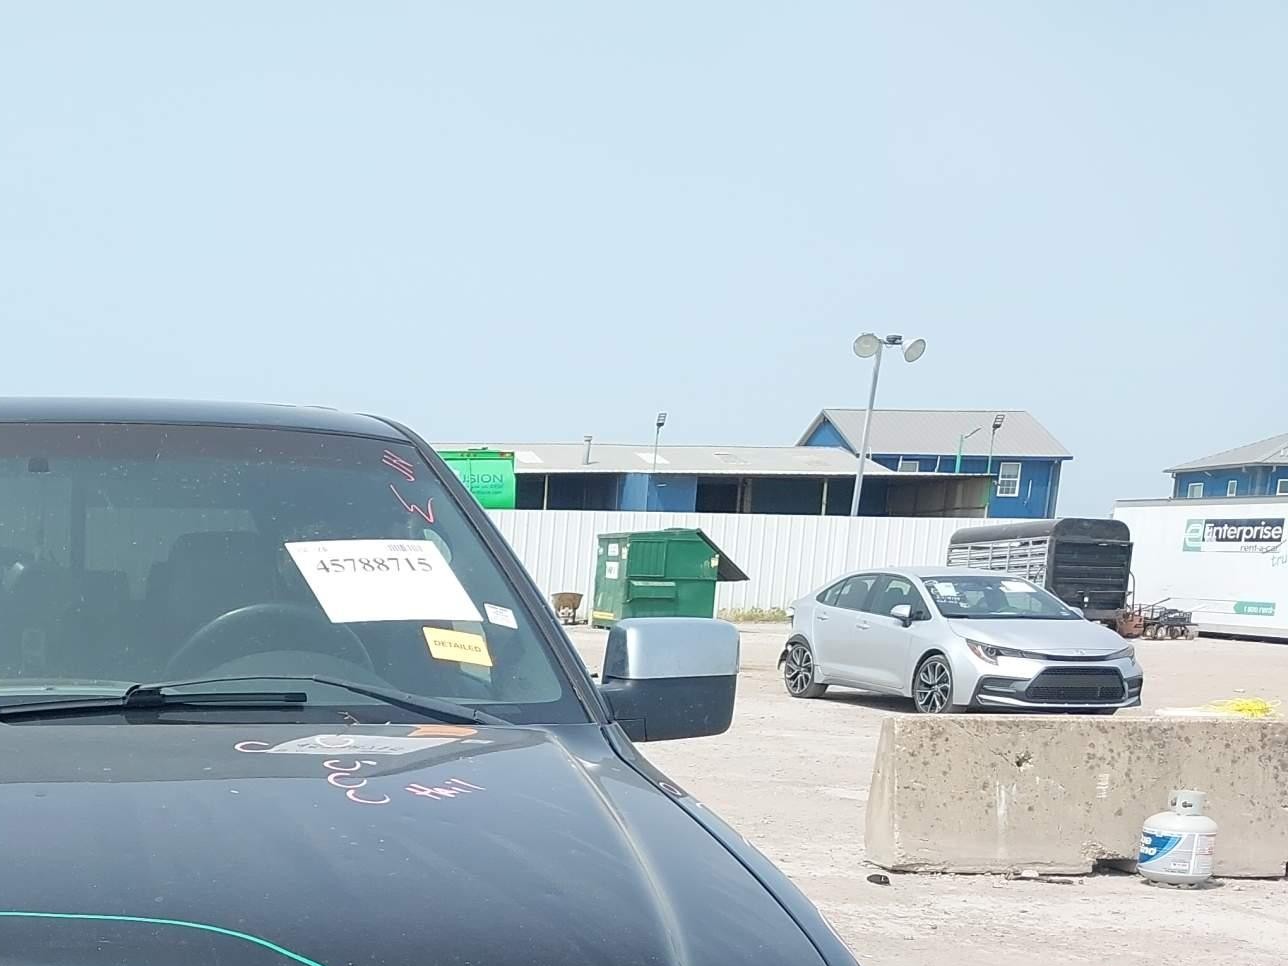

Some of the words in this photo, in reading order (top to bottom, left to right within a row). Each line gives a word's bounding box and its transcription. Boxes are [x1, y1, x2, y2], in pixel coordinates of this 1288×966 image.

[1204, 521, 1283, 543] Enterprise
[316, 557, 433, 573] 45788715
[433, 640, 482, 653] DETAILED
